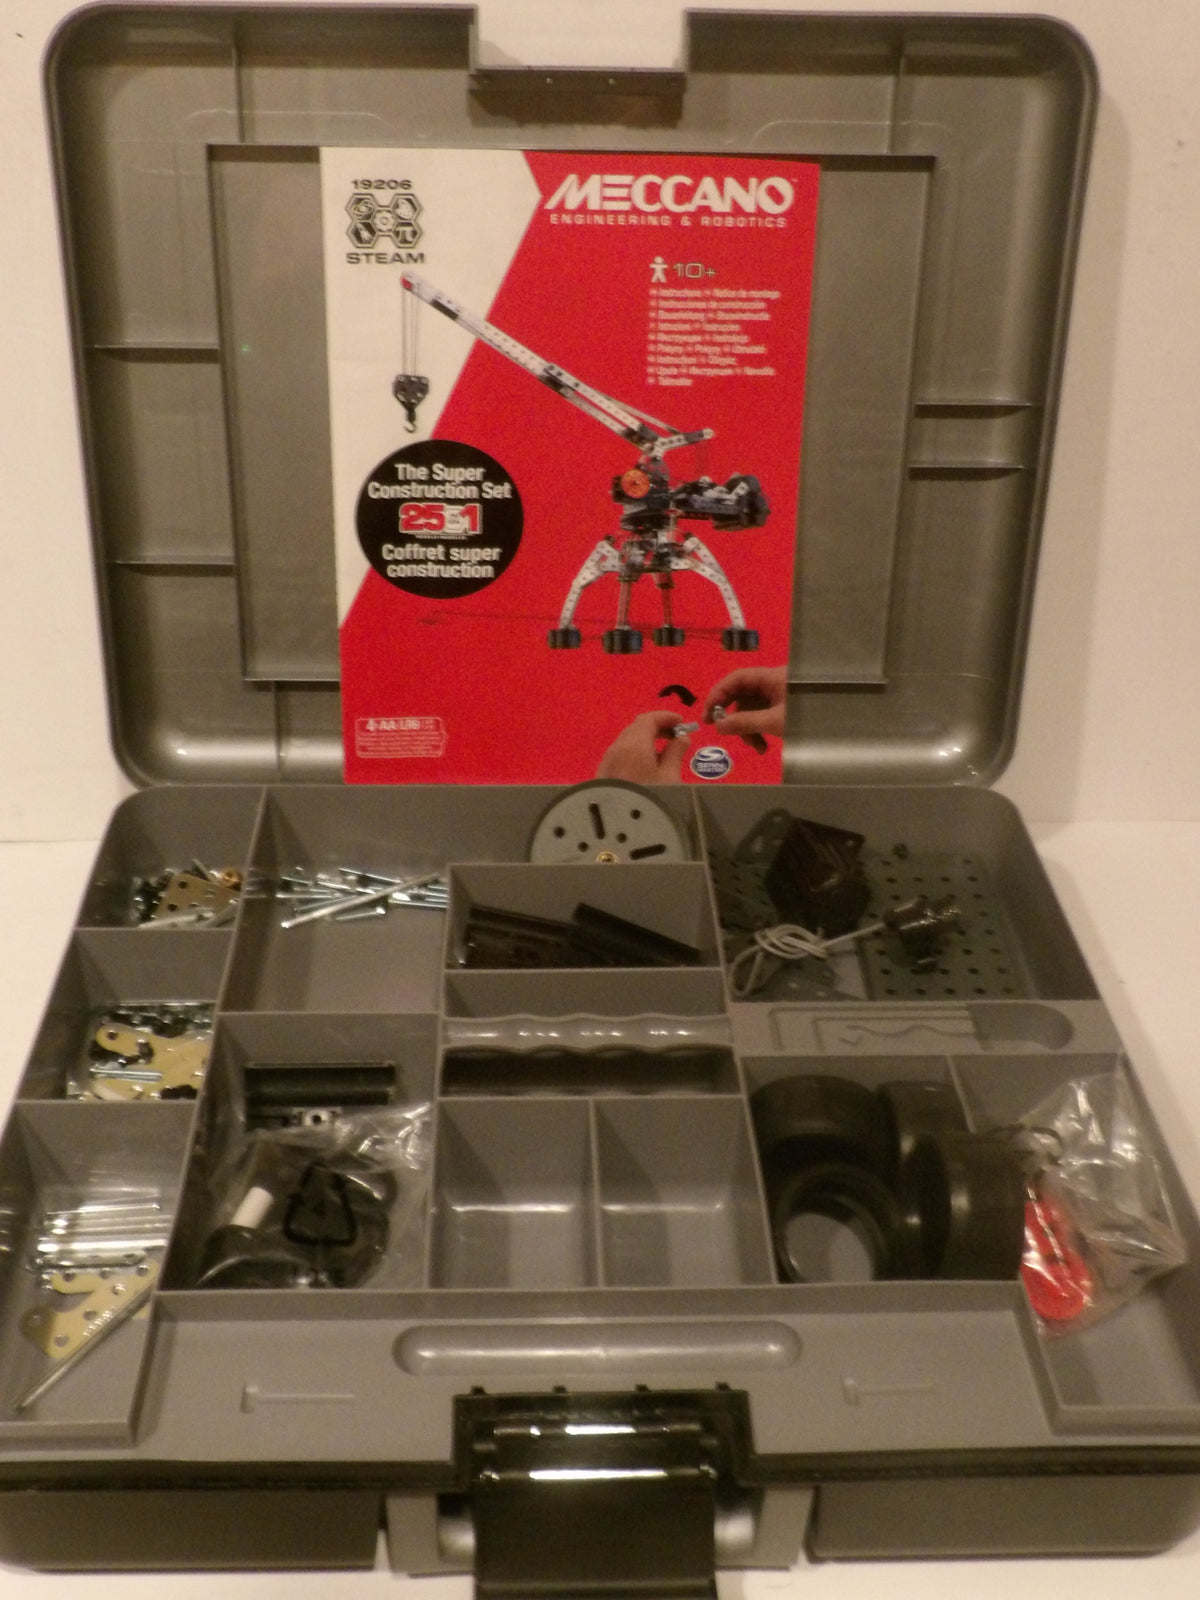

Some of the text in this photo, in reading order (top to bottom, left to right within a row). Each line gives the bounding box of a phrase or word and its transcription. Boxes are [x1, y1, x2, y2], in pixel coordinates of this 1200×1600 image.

[352, 179, 412, 190] 19206
[544, 173, 794, 214] MECCANO
[550, 214, 787, 228] ENGINEERING & ROBOTICS
[346, 252, 425, 264] STEAM
[672, 262, 716, 279] 10+
[395, 463, 486, 484] The Super
[367, 482, 512, 500] Construction Set
[400, 503, 480, 533] 25 1
[381, 544, 502, 564] Coffret super
[386, 563, 495, 579] construction
